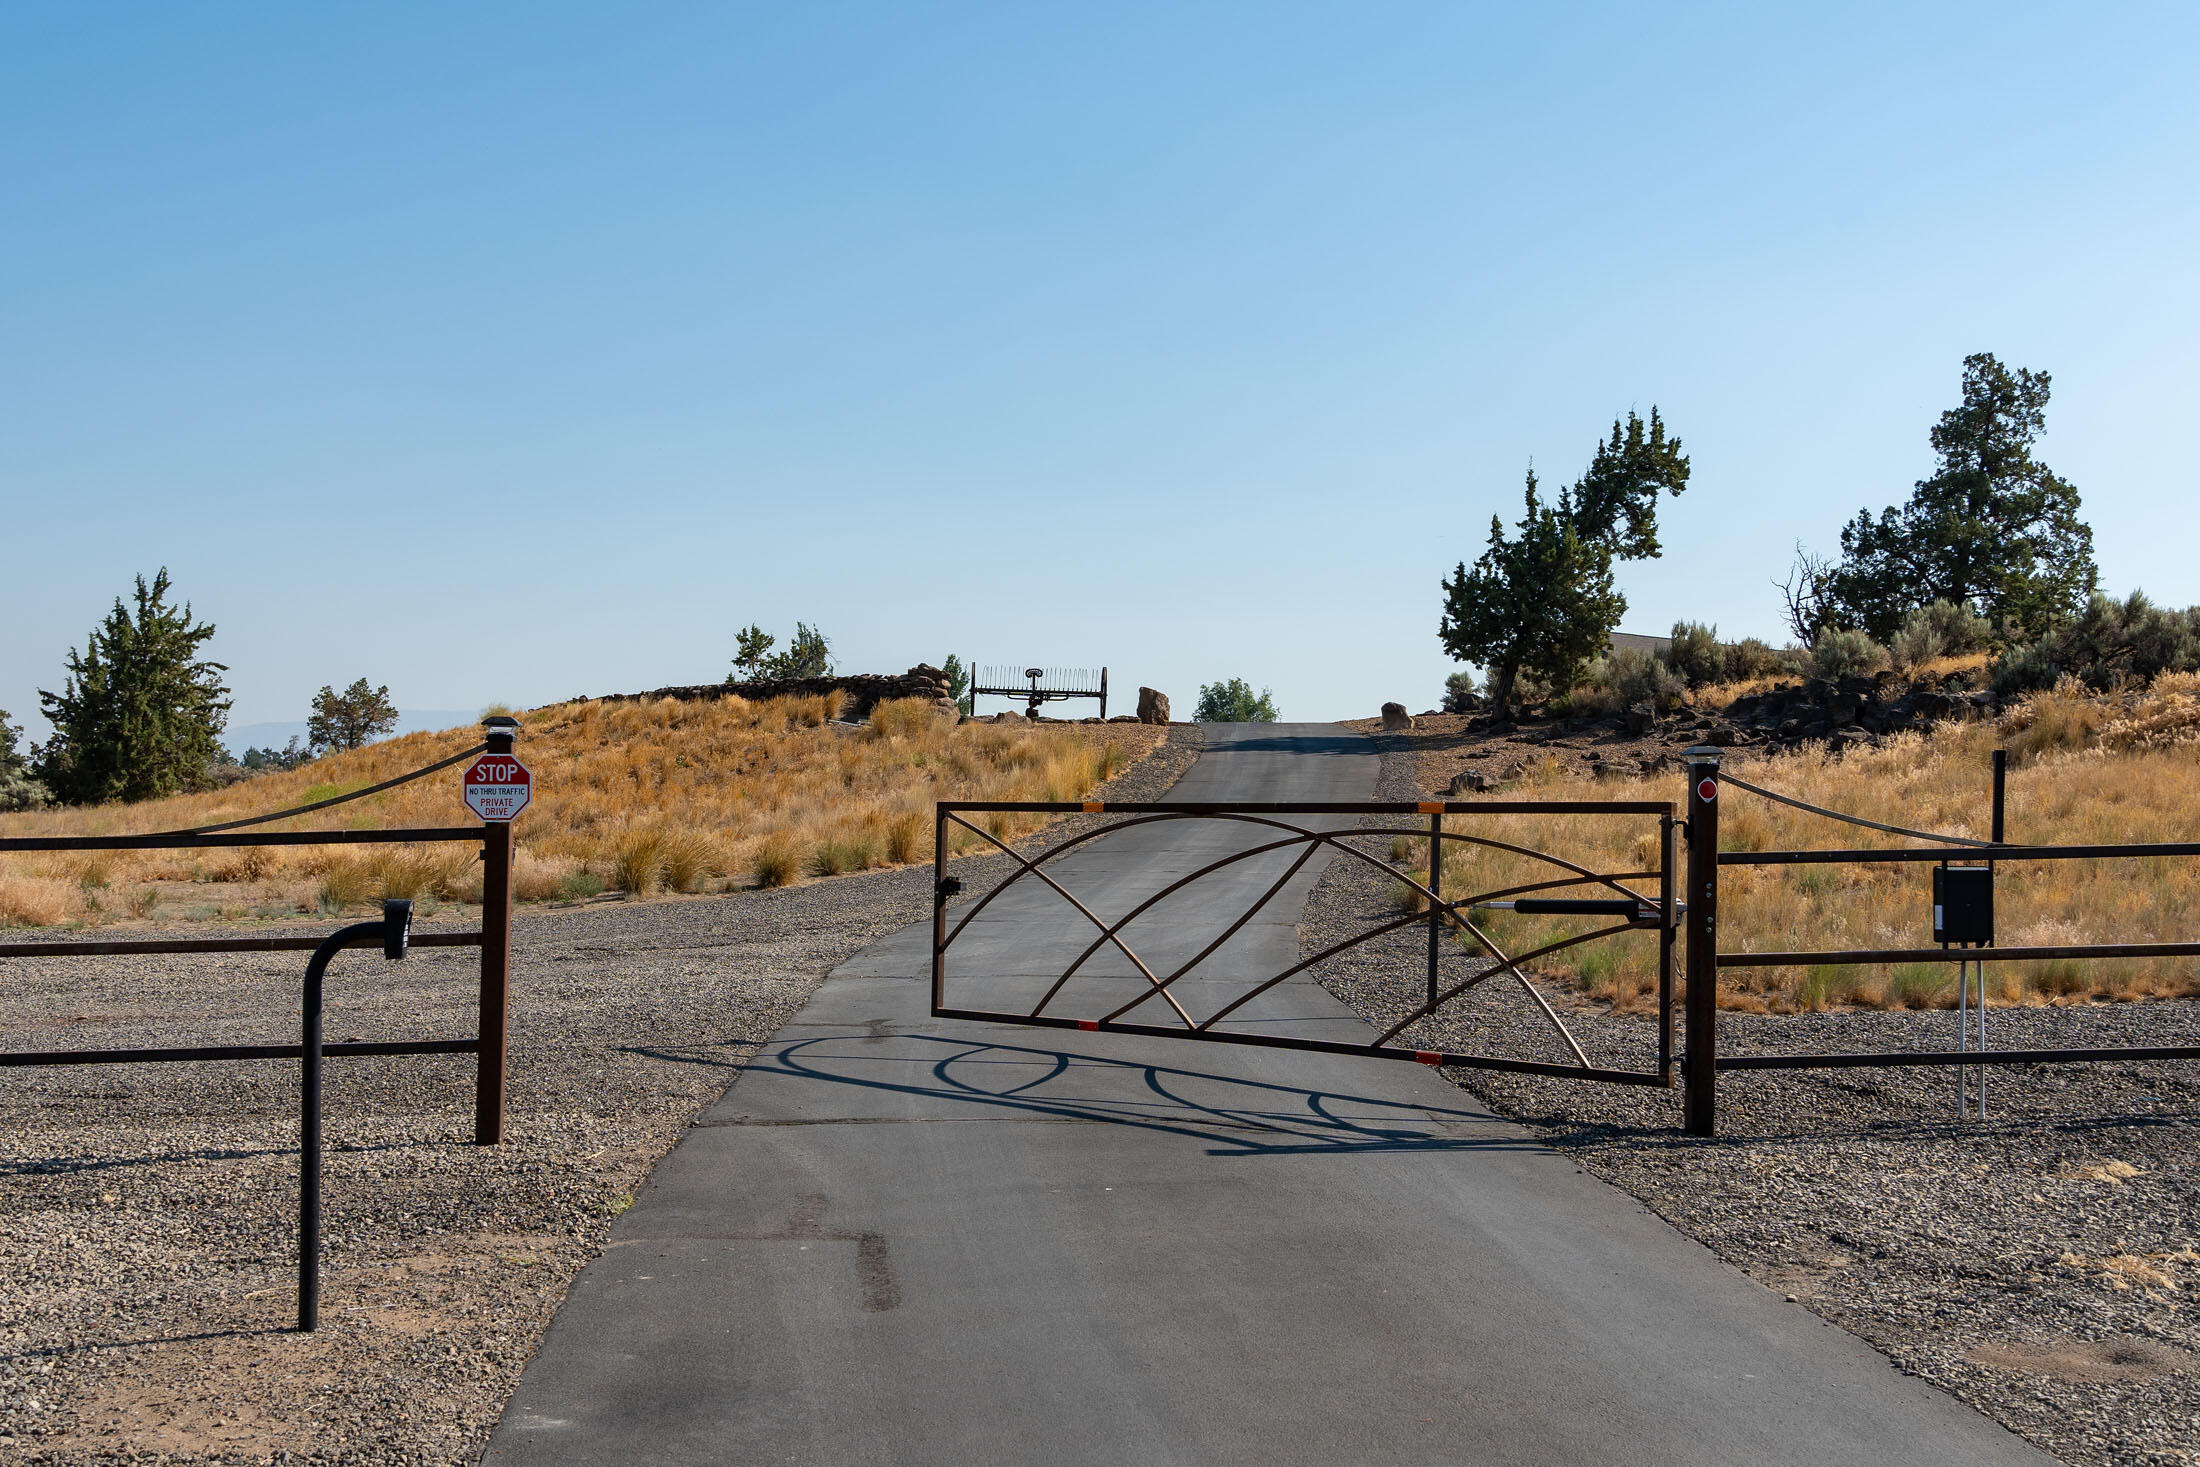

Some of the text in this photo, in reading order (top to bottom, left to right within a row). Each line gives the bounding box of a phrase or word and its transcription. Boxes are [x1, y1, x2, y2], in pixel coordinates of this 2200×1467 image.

[476, 764, 518, 782] STOP
[480, 798, 513, 807] PRIVATE
[485, 808, 508, 816] DRIVE
